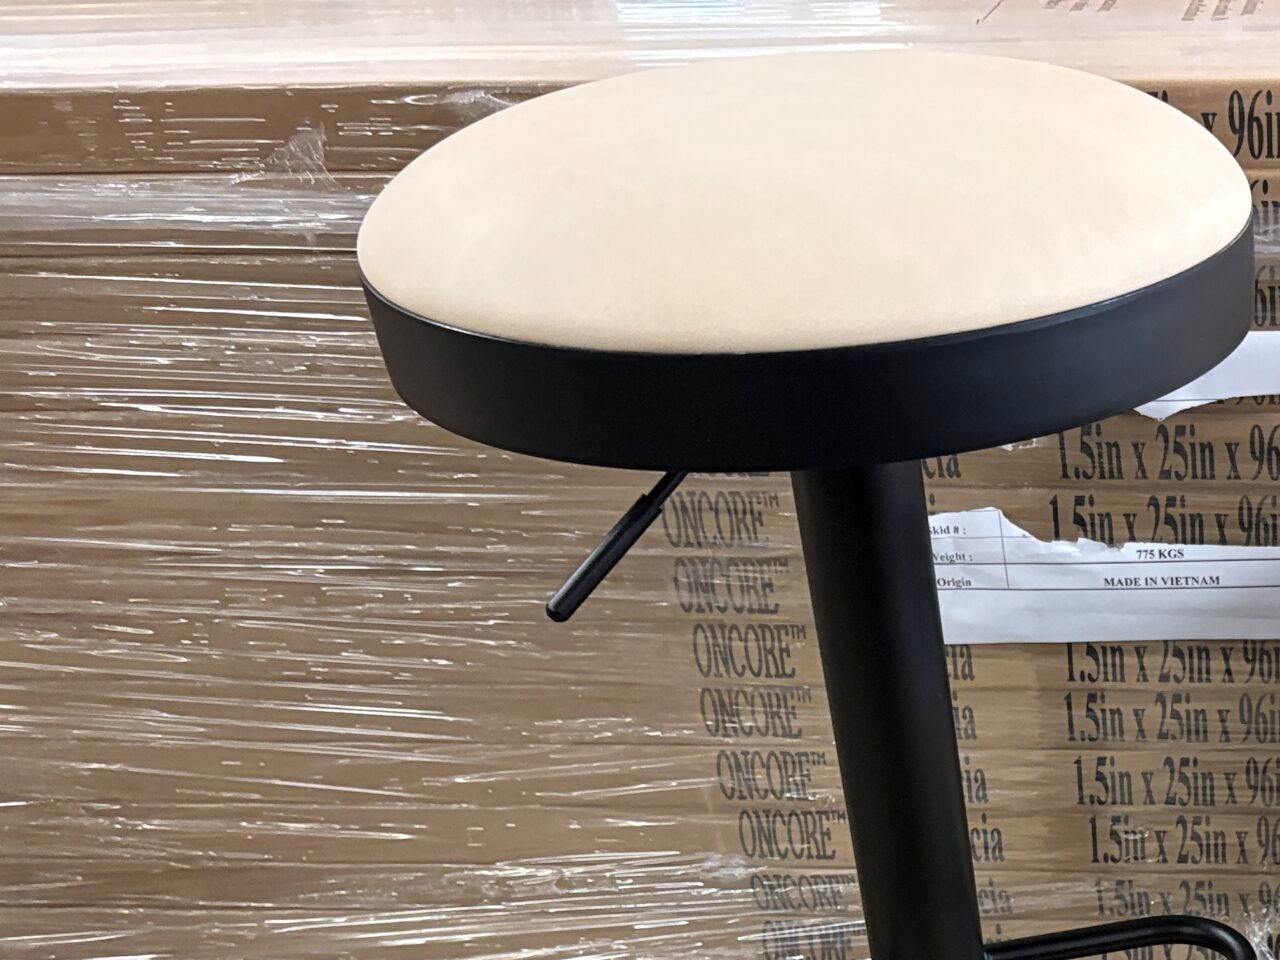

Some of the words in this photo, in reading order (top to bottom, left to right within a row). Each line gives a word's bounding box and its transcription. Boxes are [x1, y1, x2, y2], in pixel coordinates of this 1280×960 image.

[1131, 442, 1150, 480] x
[1155, 423, 1217, 481] 25in
[1224, 442, 1242, 481] x
[1136, 549, 1156, 560] 775
[1158, 549, 1185, 559] KGS
[937, 577, 972, 589] Origin
[1104, 577, 1141, 588] MADE
[1144, 576, 1158, 587] IN
[1162, 575, 1221, 587] VIETNAM
[1134, 645, 1150, 683] x
[1158, 640, 1212, 684] 25in
[1220, 645, 1235, 683] x
[1063, 692, 1126, 743] 1.5in
[1132, 708, 1148, 742] x
[1154, 692, 1209, 743] 25in
[1217, 708, 1232, 743] x
[1073, 755, 1134, 806] 1.5in
[1141, 771, 1156, 806] x
[1163, 755, 1216, 807] 25in
[1223, 771, 1238, 805] x
[1088, 814, 1148, 864] 1.5in
[1154, 829, 1169, 864] x
[1176, 814, 1228, 865] 25in
[1235, 829, 1249, 865] x
